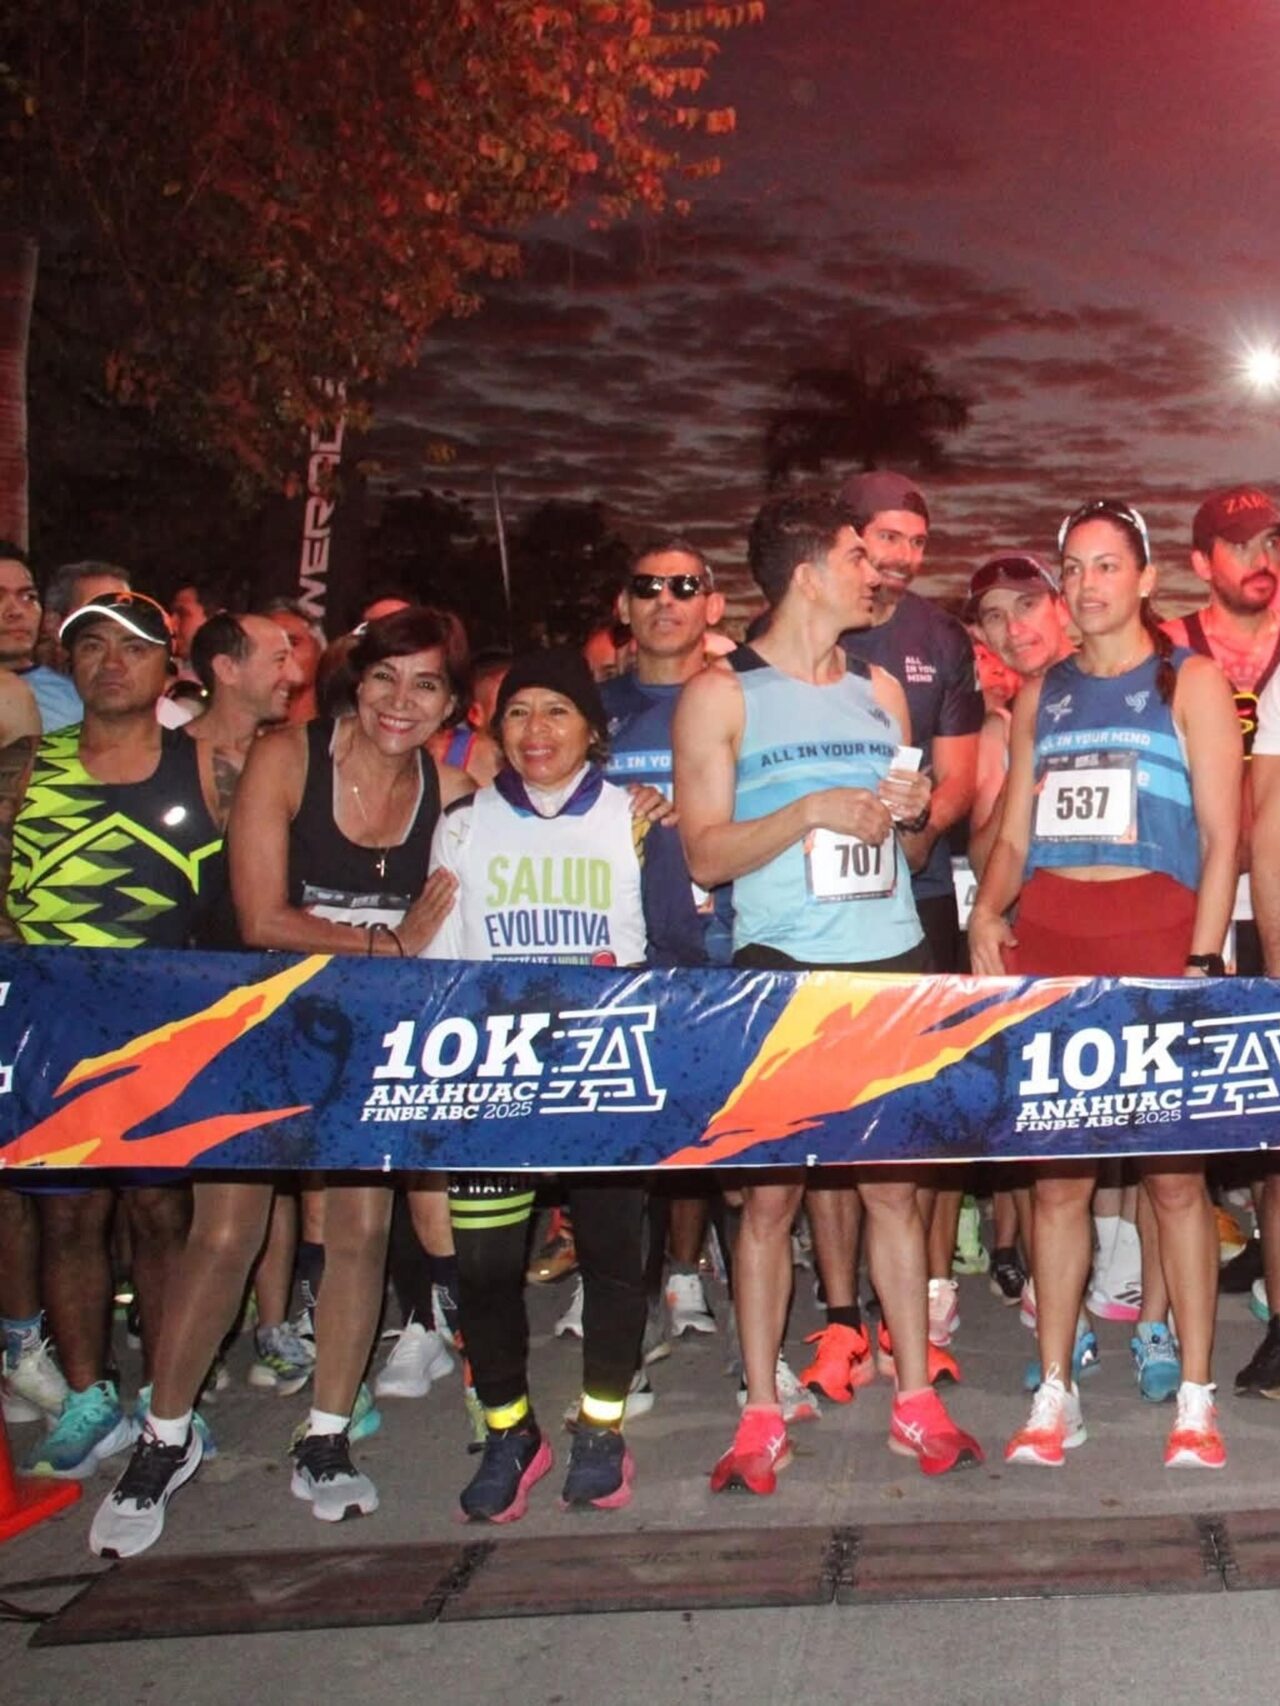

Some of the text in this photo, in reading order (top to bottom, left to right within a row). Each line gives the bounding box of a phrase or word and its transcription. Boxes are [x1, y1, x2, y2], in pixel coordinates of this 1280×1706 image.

[1056, 733, 1072, 746] IN
[1075, 732, 1109, 745] YOUR
[1111, 730, 1150, 746] MIND
[627, 755, 645, 769] IN
[761, 749, 794, 768] ALL
[797, 745, 818, 758] IN
[821, 743, 865, 758] YOUR
[1056, 786, 1110, 820] 537
[834, 843, 881, 878] 707
[485, 854, 612, 911] SALUD
[484, 908, 611, 947] EVOLUTIVA
[372, 1012, 550, 1079] 10K
[1019, 1021, 1185, 1096] 10K
[364, 1079, 539, 1106] ANÁHUAC
[1017, 1088, 1183, 1121] ANÁHUAC
[360, 1101, 532, 1122] FINBE ABC 2025
[1015, 1110, 1182, 1132] FINBE ABC 2025
